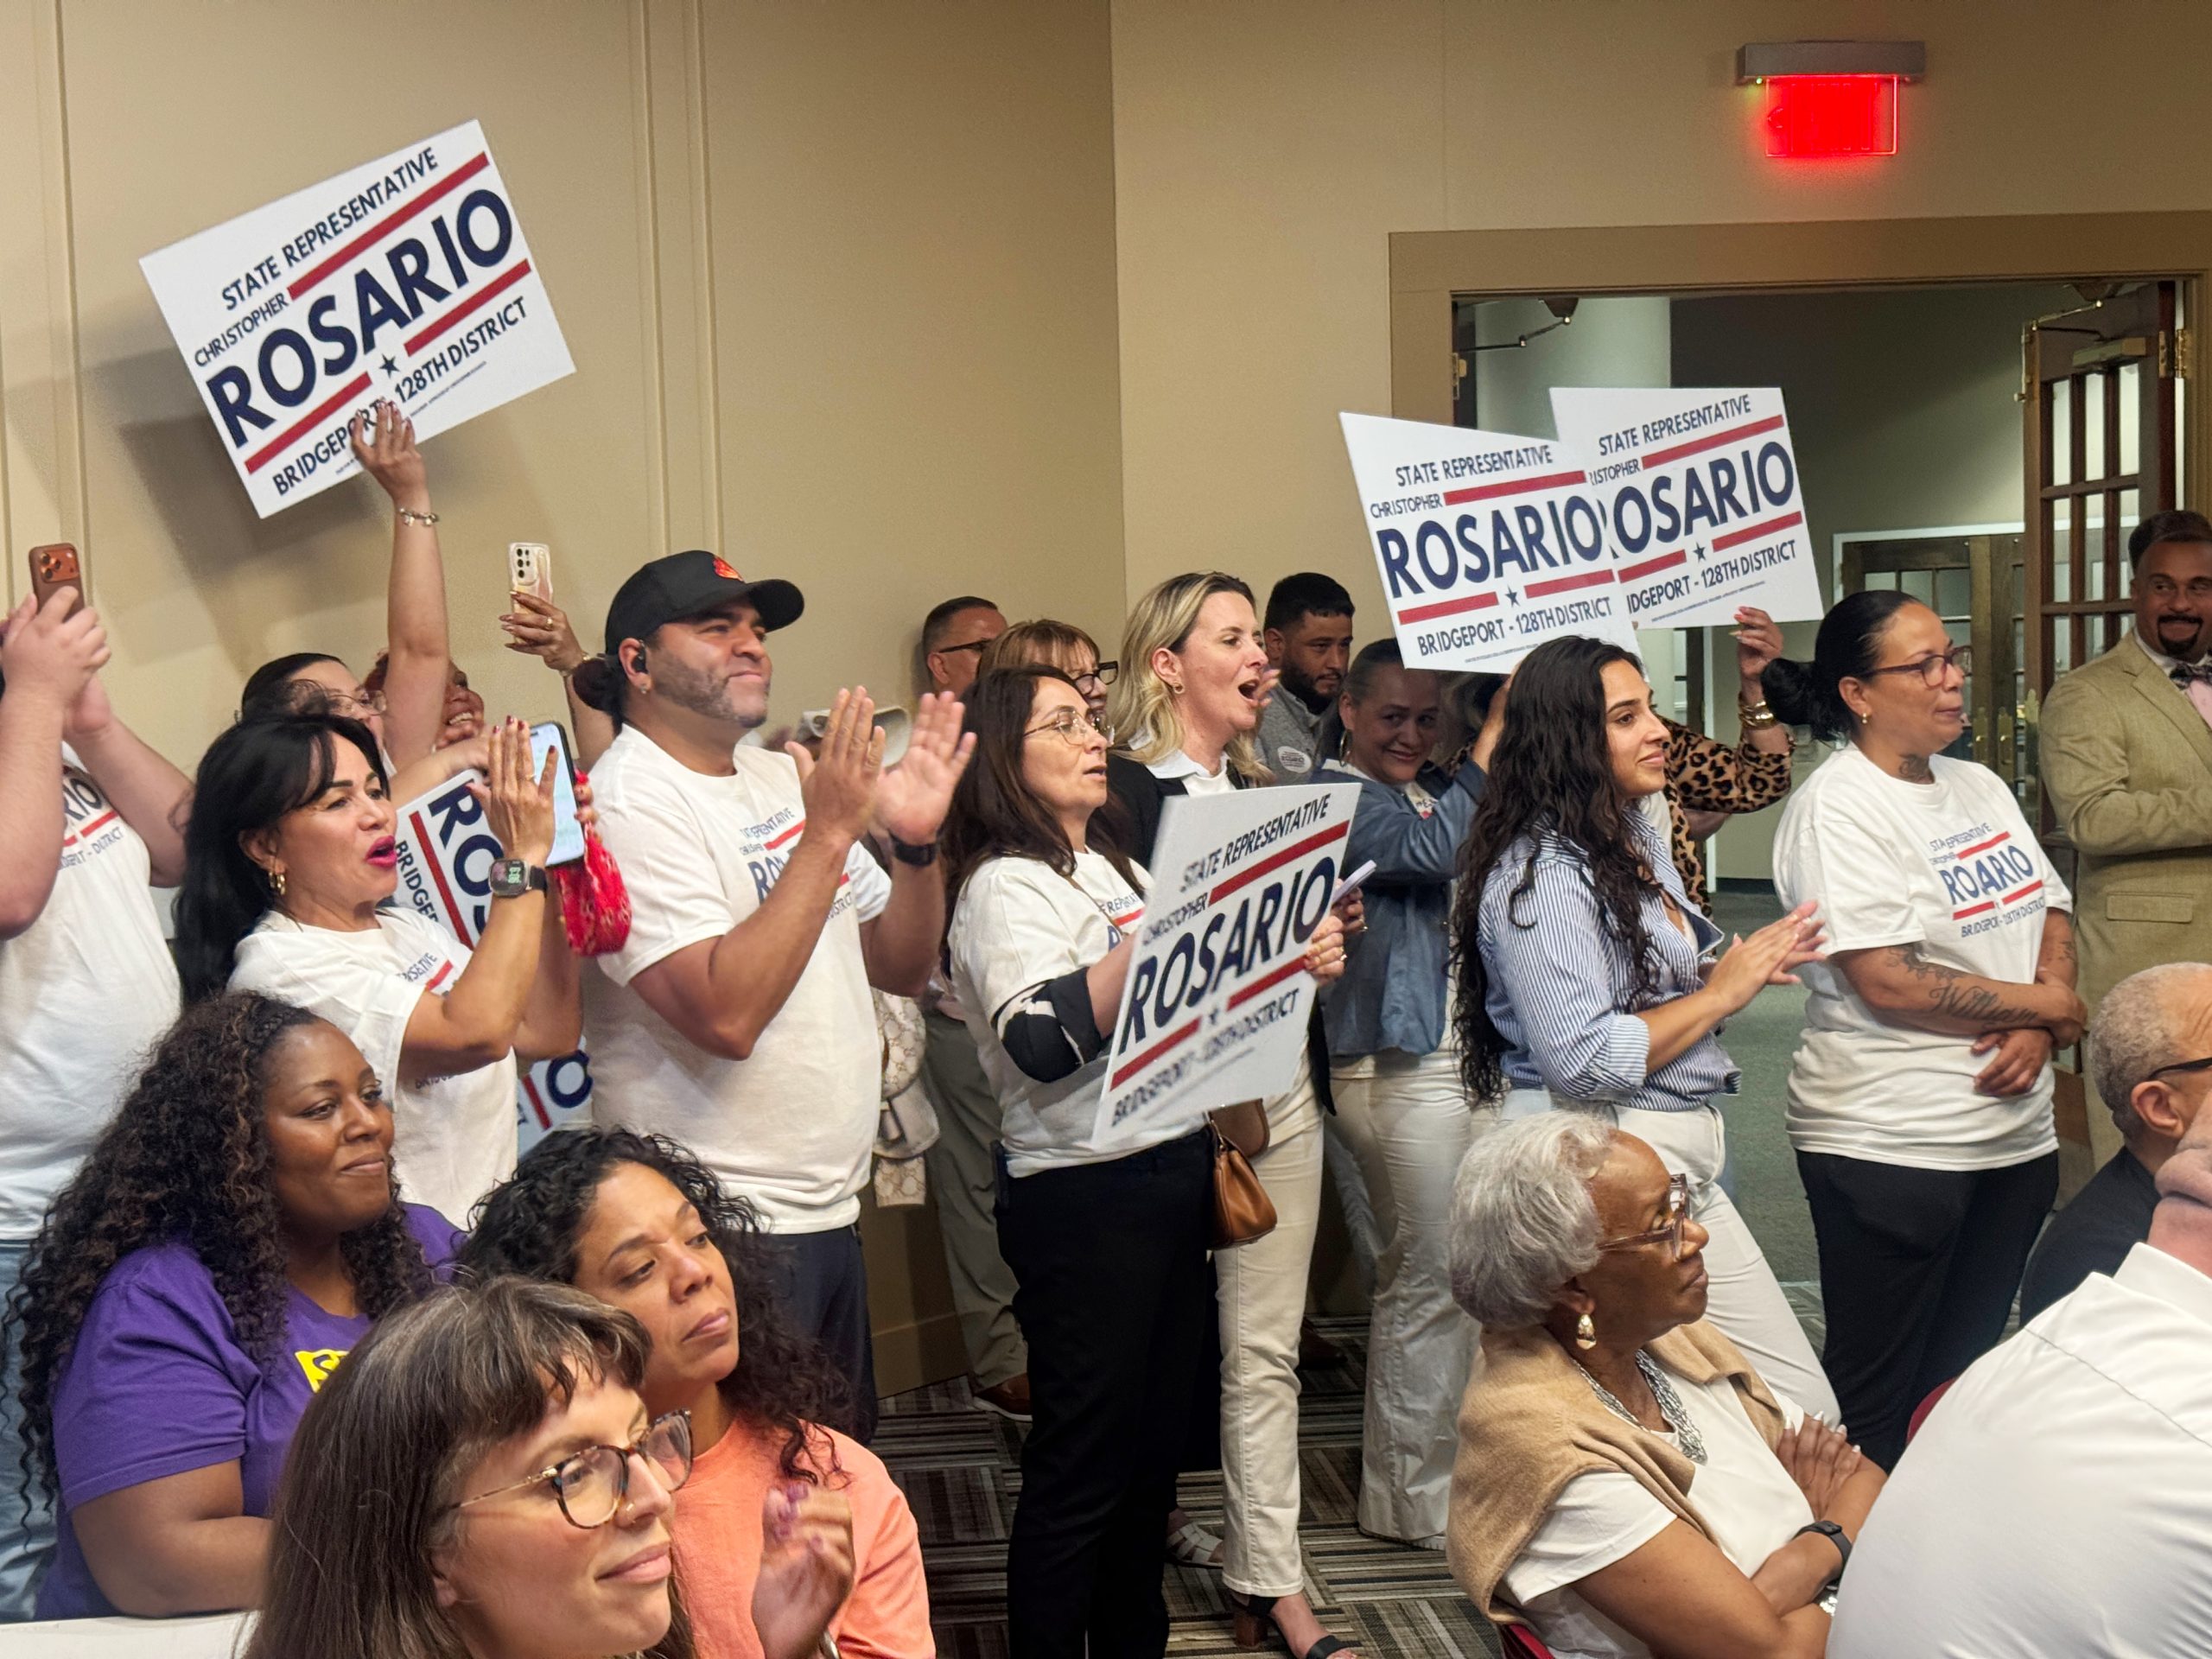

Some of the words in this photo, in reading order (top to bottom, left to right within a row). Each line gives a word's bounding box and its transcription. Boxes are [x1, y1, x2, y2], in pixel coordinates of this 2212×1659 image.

[221, 257, 281, 310] STATE
[282, 147, 438, 269] REPRESENTATIVE
[194, 290, 289, 367] CHRISTOPHER
[206, 189, 512, 448] ROSARIO
[395, 353, 449, 403] 128TH
[448, 296, 528, 367] DISTRICT
[1599, 427, 1640, 456] STATE
[1643, 394, 1751, 444] REPRESENTATIVE
[1395, 461, 1440, 487] STATE
[1443, 443, 1553, 480] REPRESENTATIVE
[1590, 459, 1640, 486] ISTOPHER
[1370, 492, 1443, 518] CHRISTOPHER
[1376, 495, 1602, 598] ROSARIO
[1627, 575, 1690, 613] IDGEPORT
[1700, 561, 1739, 588] 128TH
[1740, 539, 1797, 575] DISTRICT
[1417, 618, 1505, 657] BRIDGEPORT
[1515, 607, 1557, 634] 128TH
[1555, 597, 1613, 626] DISTRICT
[1223, 793, 1332, 869] REPRESENTATIVE
[1118, 856, 1336, 1056] ROSARIO
